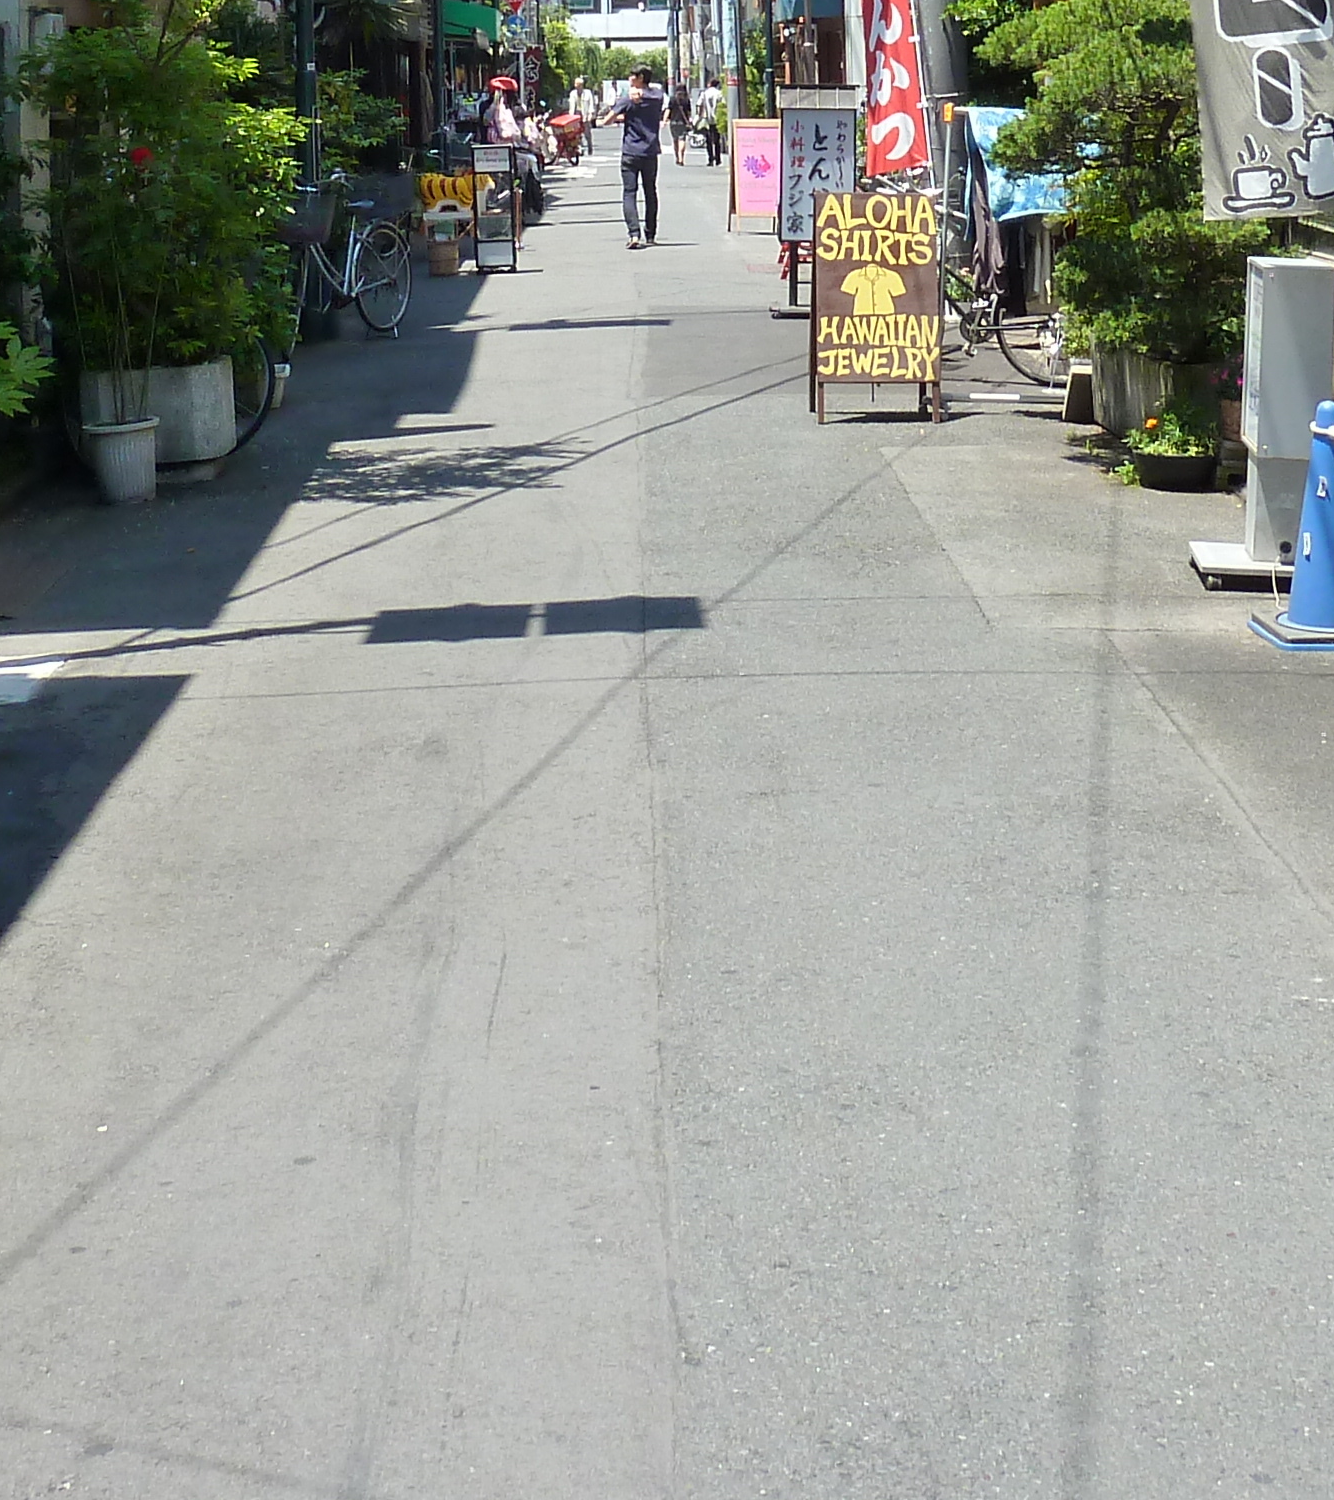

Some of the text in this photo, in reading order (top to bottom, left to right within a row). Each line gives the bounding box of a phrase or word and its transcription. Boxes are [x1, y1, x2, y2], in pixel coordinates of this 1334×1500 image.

[816, 193, 937, 235] ALOHA
[816, 227, 933, 266] SHIRTS
[817, 313, 939, 349] HAWAIIAN
[817, 346, 940, 382] JEWELRY
